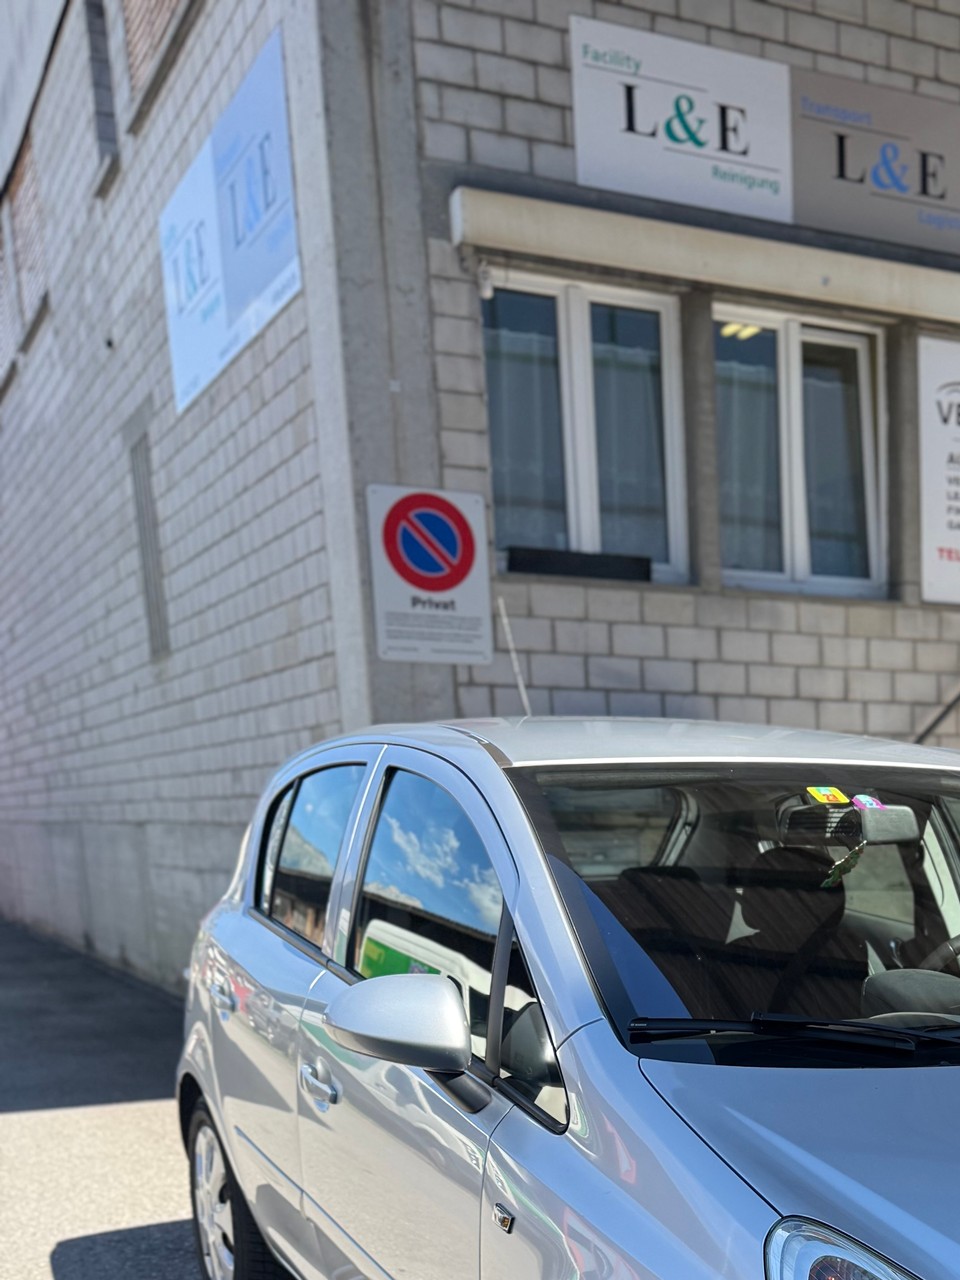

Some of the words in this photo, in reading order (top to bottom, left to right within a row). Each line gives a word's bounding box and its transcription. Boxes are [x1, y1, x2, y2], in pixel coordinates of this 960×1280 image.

[581, 43, 642, 75] Facility
[618, 82, 750, 157] L&E
[800, 96, 873, 126] Transport
[711, 164, 781, 195] Reinigung
[832, 131, 948, 200] L&E
[411, 595, 456, 611] Privat
